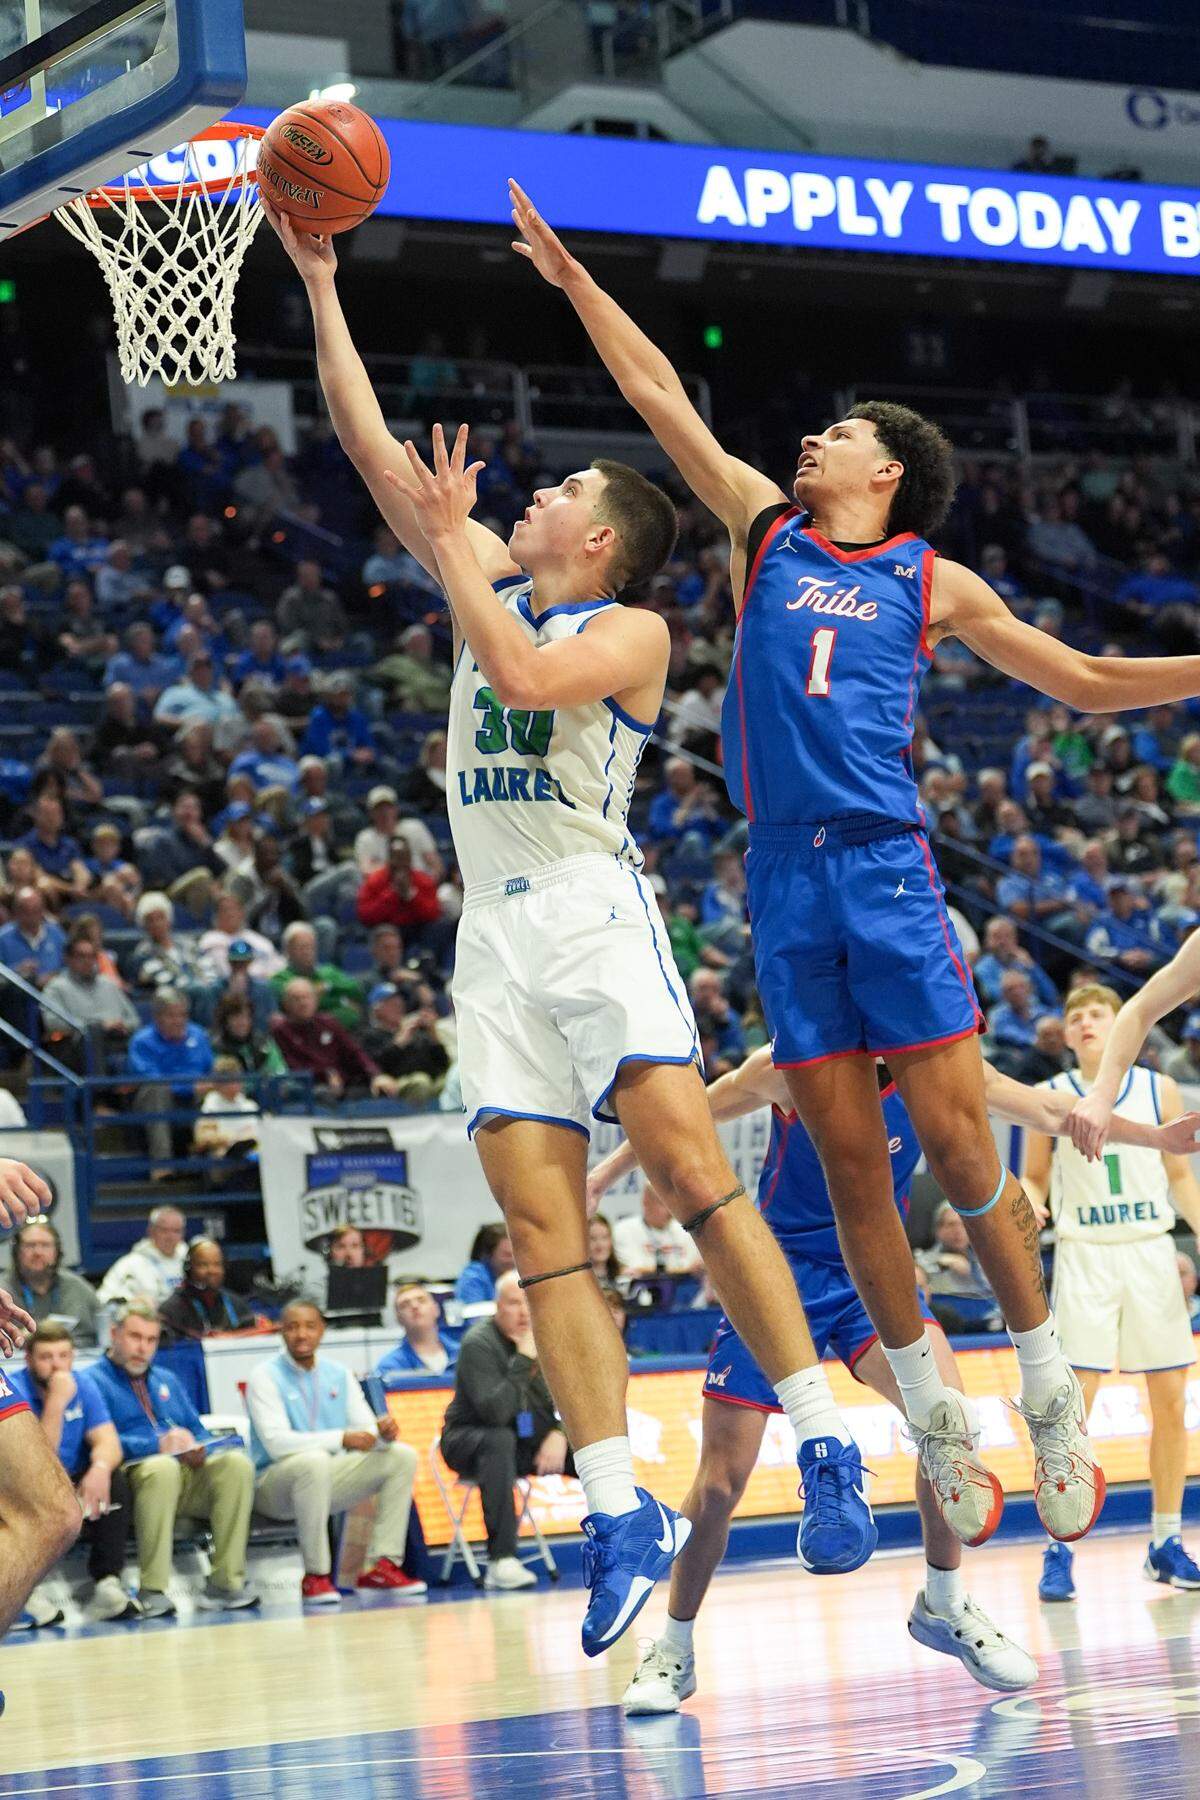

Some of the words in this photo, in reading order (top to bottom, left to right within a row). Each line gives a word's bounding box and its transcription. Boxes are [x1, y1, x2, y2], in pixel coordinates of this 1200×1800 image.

[697, 165, 913, 238] APPLY
[925, 183, 1140, 255] TODAY
[1159, 200, 1200, 258] B
[786, 576, 878, 621] Tribe
[806, 627, 838, 697] 1
[472, 685, 556, 758] 30
[1104, 1154, 1122, 1195] 1
[303, 1190, 384, 1231] SWEET
[1077, 1201, 1159, 1226] LAUREL
